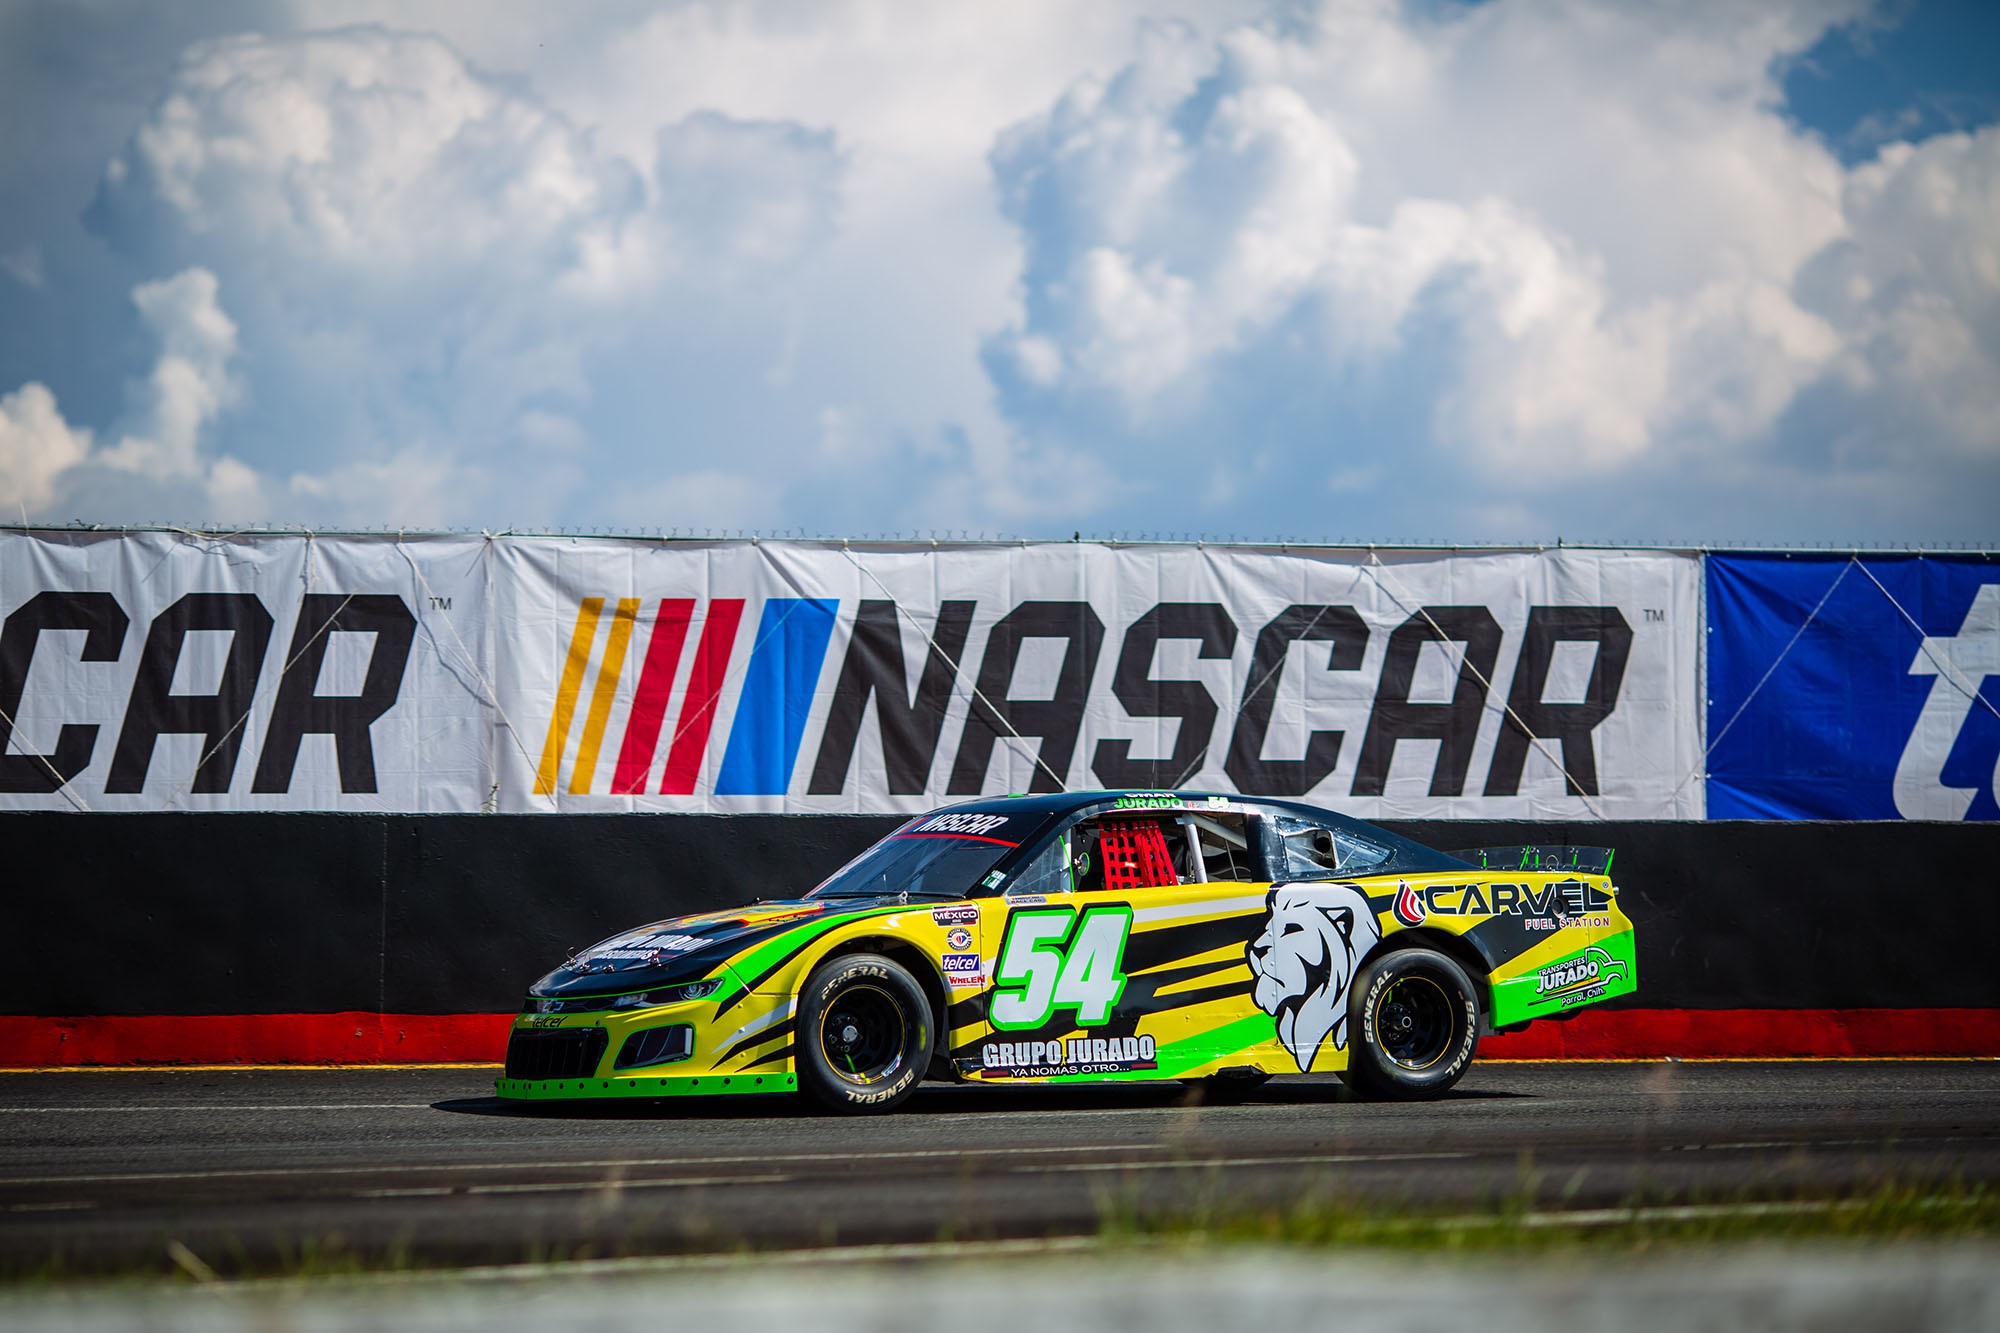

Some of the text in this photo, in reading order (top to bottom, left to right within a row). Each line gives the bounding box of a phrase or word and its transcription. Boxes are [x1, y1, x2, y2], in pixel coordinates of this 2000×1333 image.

[1643, 610, 1665, 622] TM
[0, 591, 418, 795] CAR
[807, 599, 1634, 796] NASCAR
[1114, 797, 1184, 809] JURADO
[1208, 796, 1231, 810] 54
[913, 814, 1010, 836] NASCAR
[1423, 882, 1609, 916] CARVEL
[934, 910, 977, 920] MÉXICO
[1525, 916, 1611, 931] FUEL STATION
[943, 956, 978, 970] telcel
[989, 907, 1133, 1031] 54
[1538, 956, 1586, 976] TRANSPORTES
[949, 974, 986, 985] WHELEN
[1535, 961, 1599, 994] JURADO
[1363, 969, 1394, 1044] GENERAL
[1444, 1001, 1477, 1077] GENERAL
[982, 1035, 1156, 1069] GRUPO JURADO
[1010, 1067, 1028, 1077] YA
[1030, 1066, 1078, 1077] NOMAS
[845, 1067, 915, 1104] GENERAL
